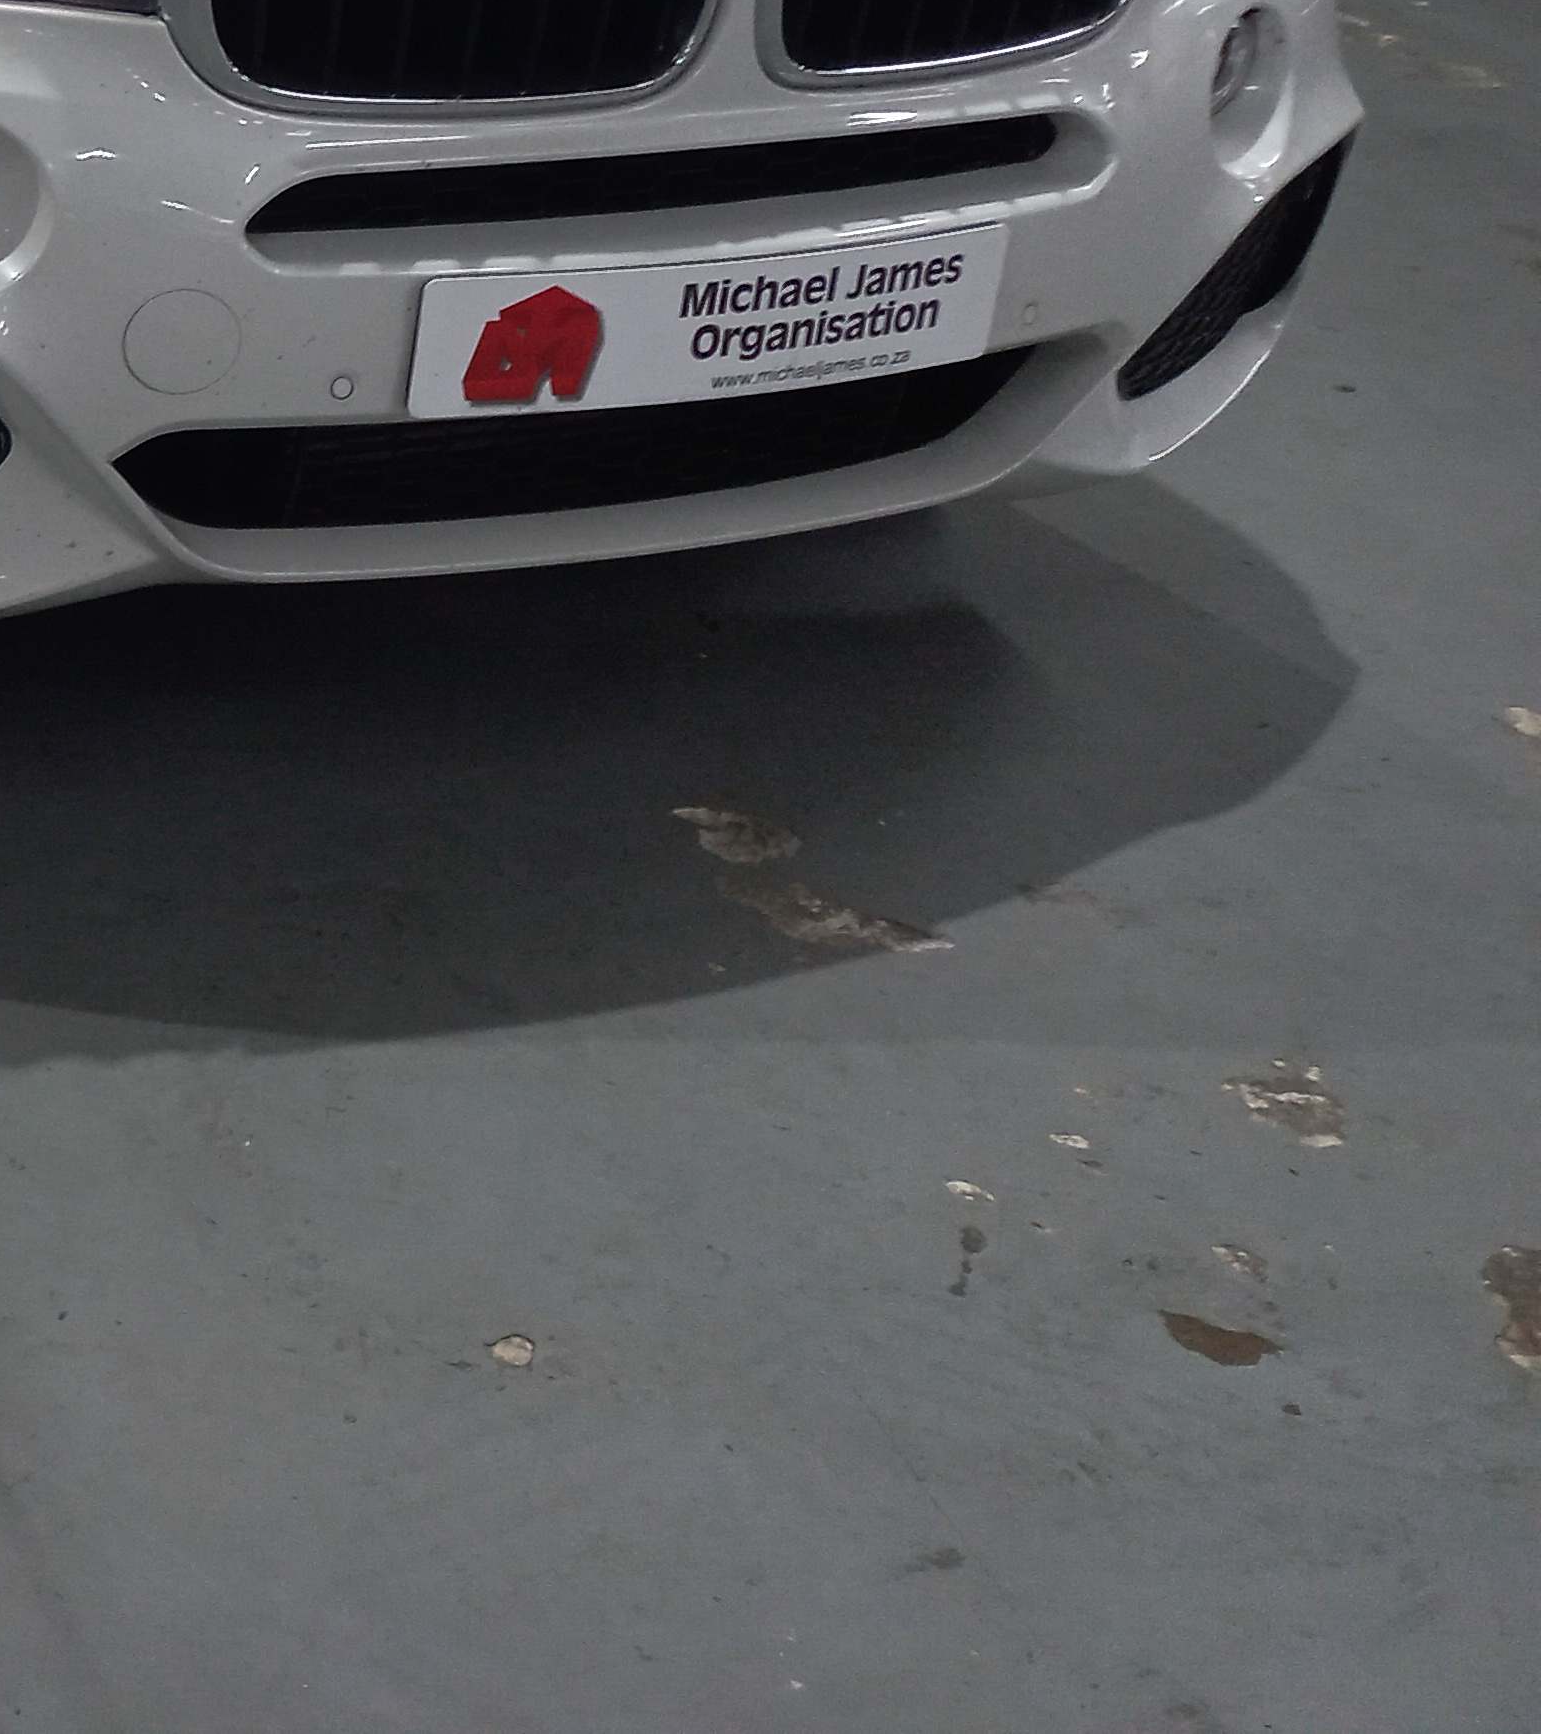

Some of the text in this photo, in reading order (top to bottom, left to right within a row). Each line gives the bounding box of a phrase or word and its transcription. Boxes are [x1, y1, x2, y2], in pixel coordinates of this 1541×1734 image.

[679, 254, 965, 319] Michael James
[691, 298, 942, 361] Organisation
